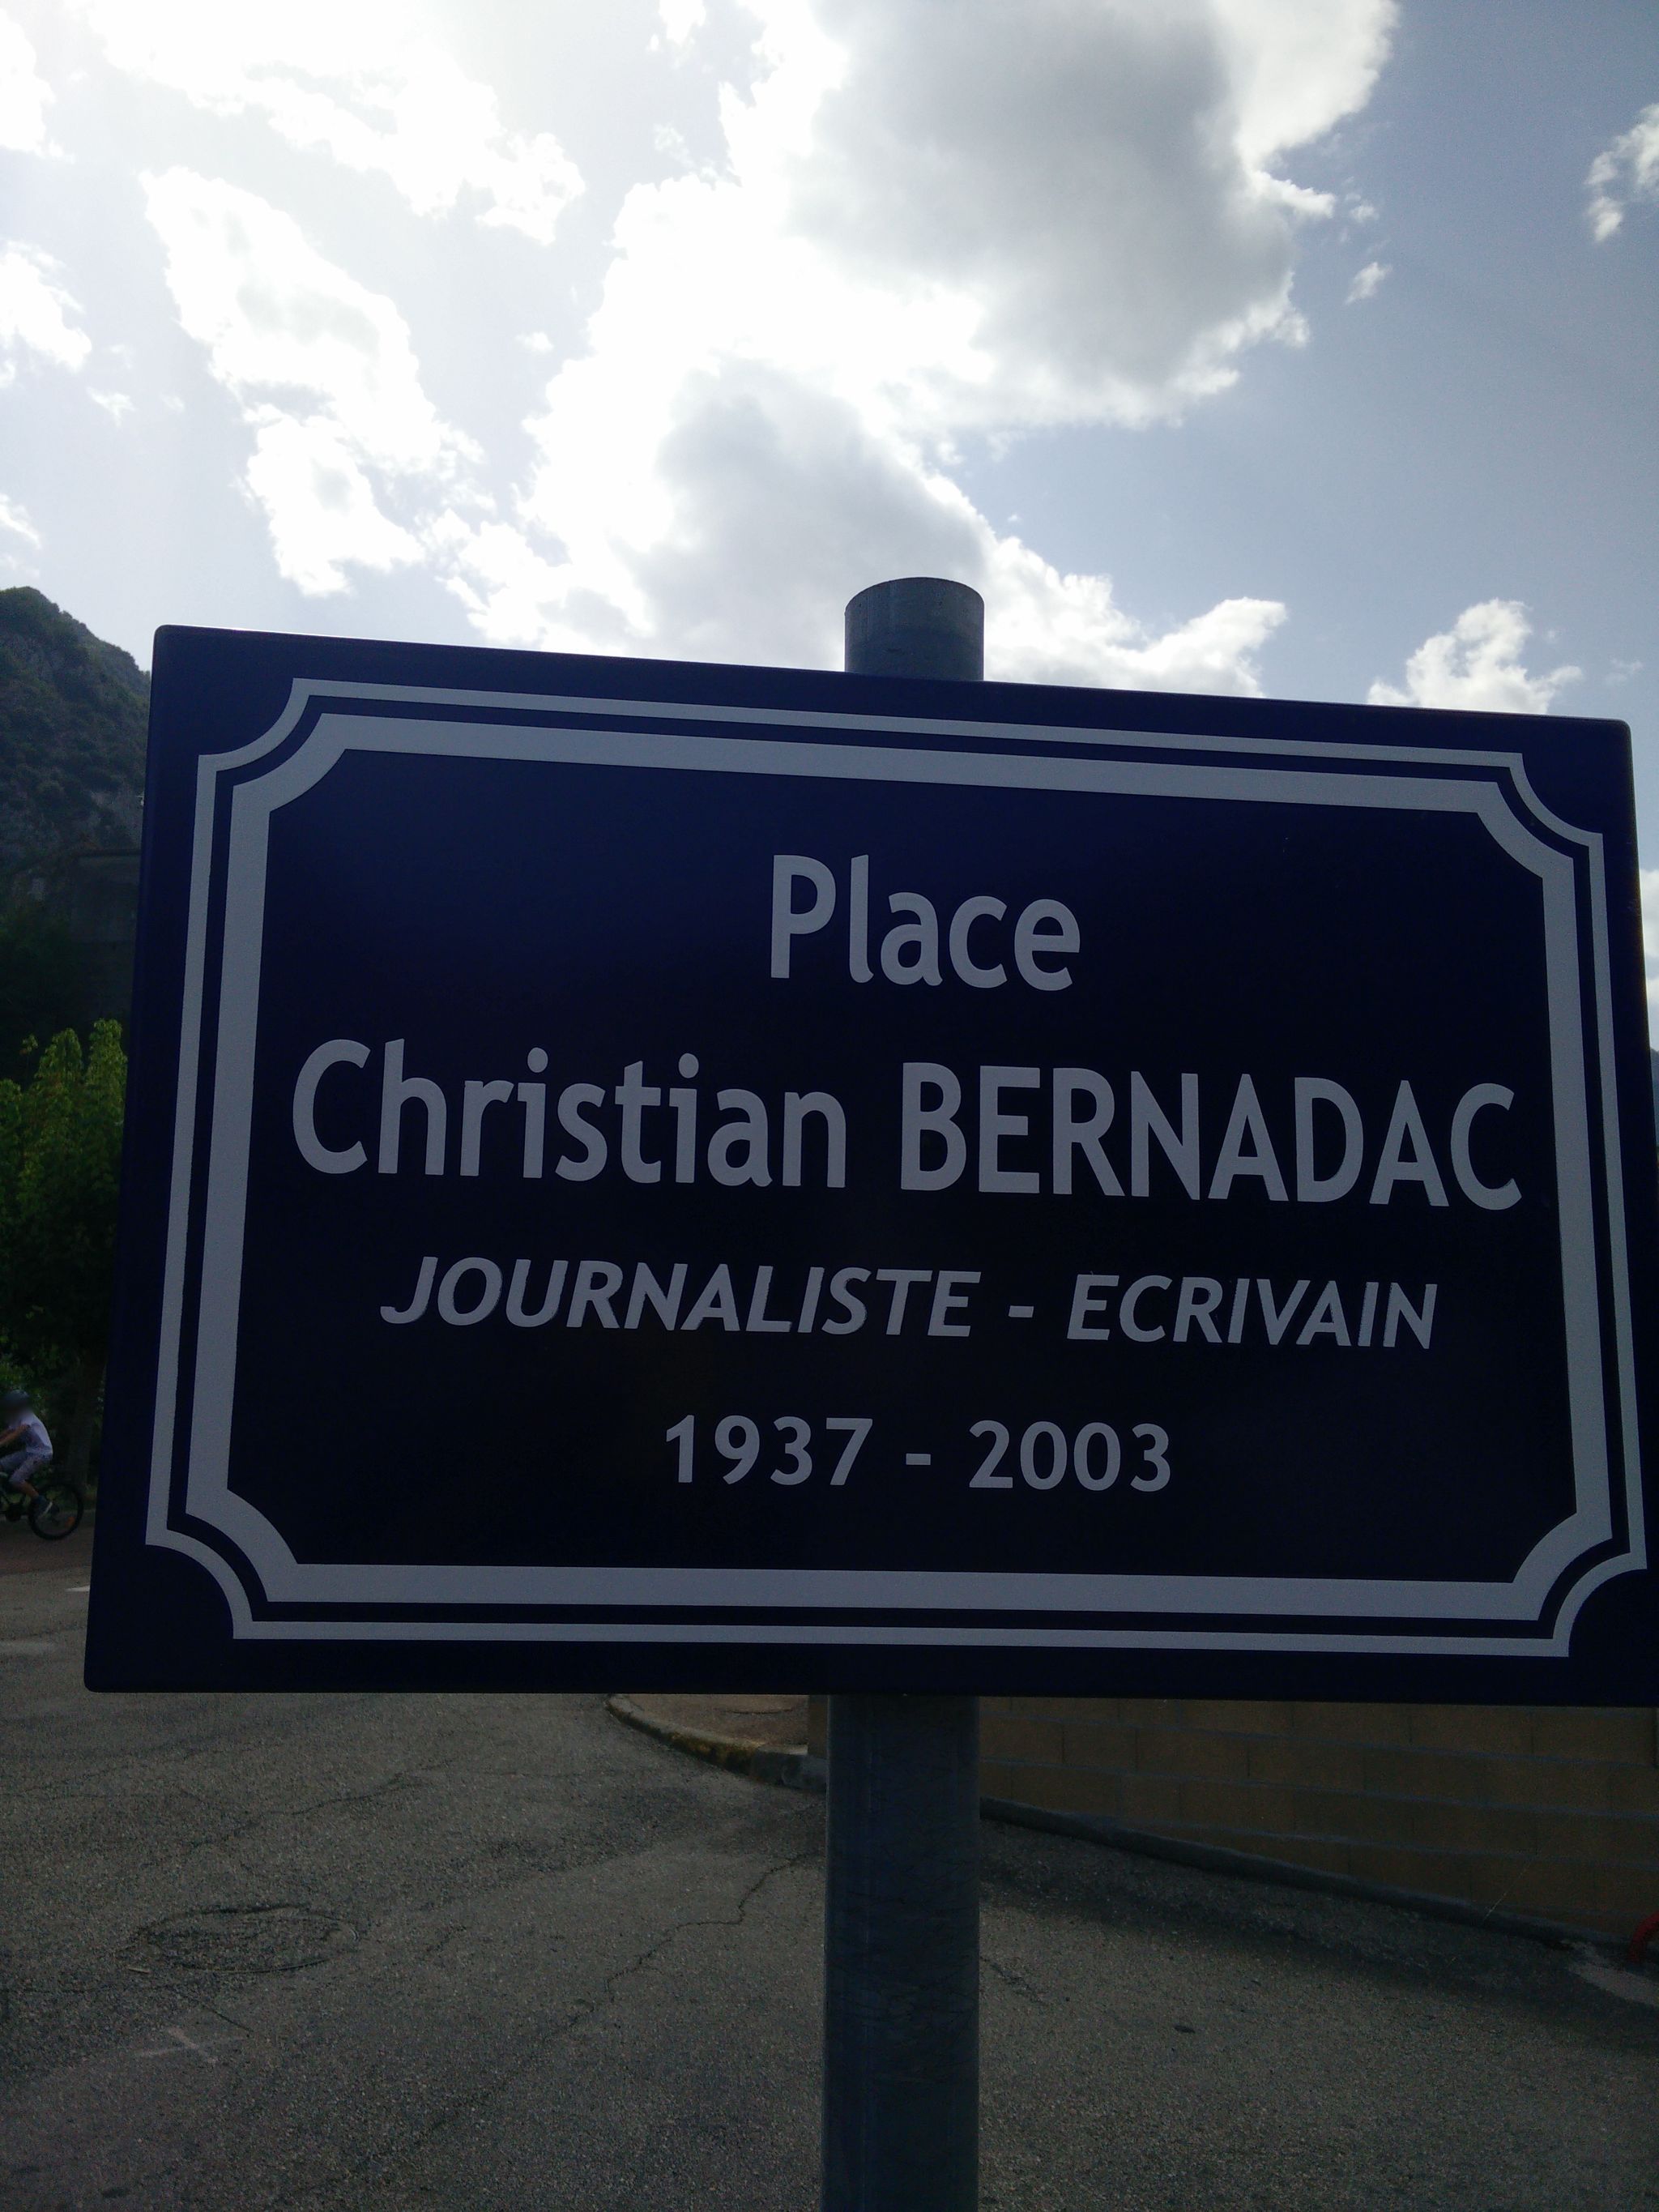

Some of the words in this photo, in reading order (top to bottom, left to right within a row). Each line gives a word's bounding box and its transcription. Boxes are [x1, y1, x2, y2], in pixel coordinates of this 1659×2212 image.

[770, 854, 1081, 991] Place
[292, 1039, 847, 1189] Christian
[900, 1061, 1523, 1211] BERNADAC
[380, 1256, 982, 1338] JOURNALISTE
[1008, 1305, 1035, 1319] -
[1066, 1274, 1439, 1349] ECRIVAIN
[666, 1415, 874, 1487] 1937
[906, 1453, 932, 1466] -
[968, 1420, 1172, 1492] 2003
